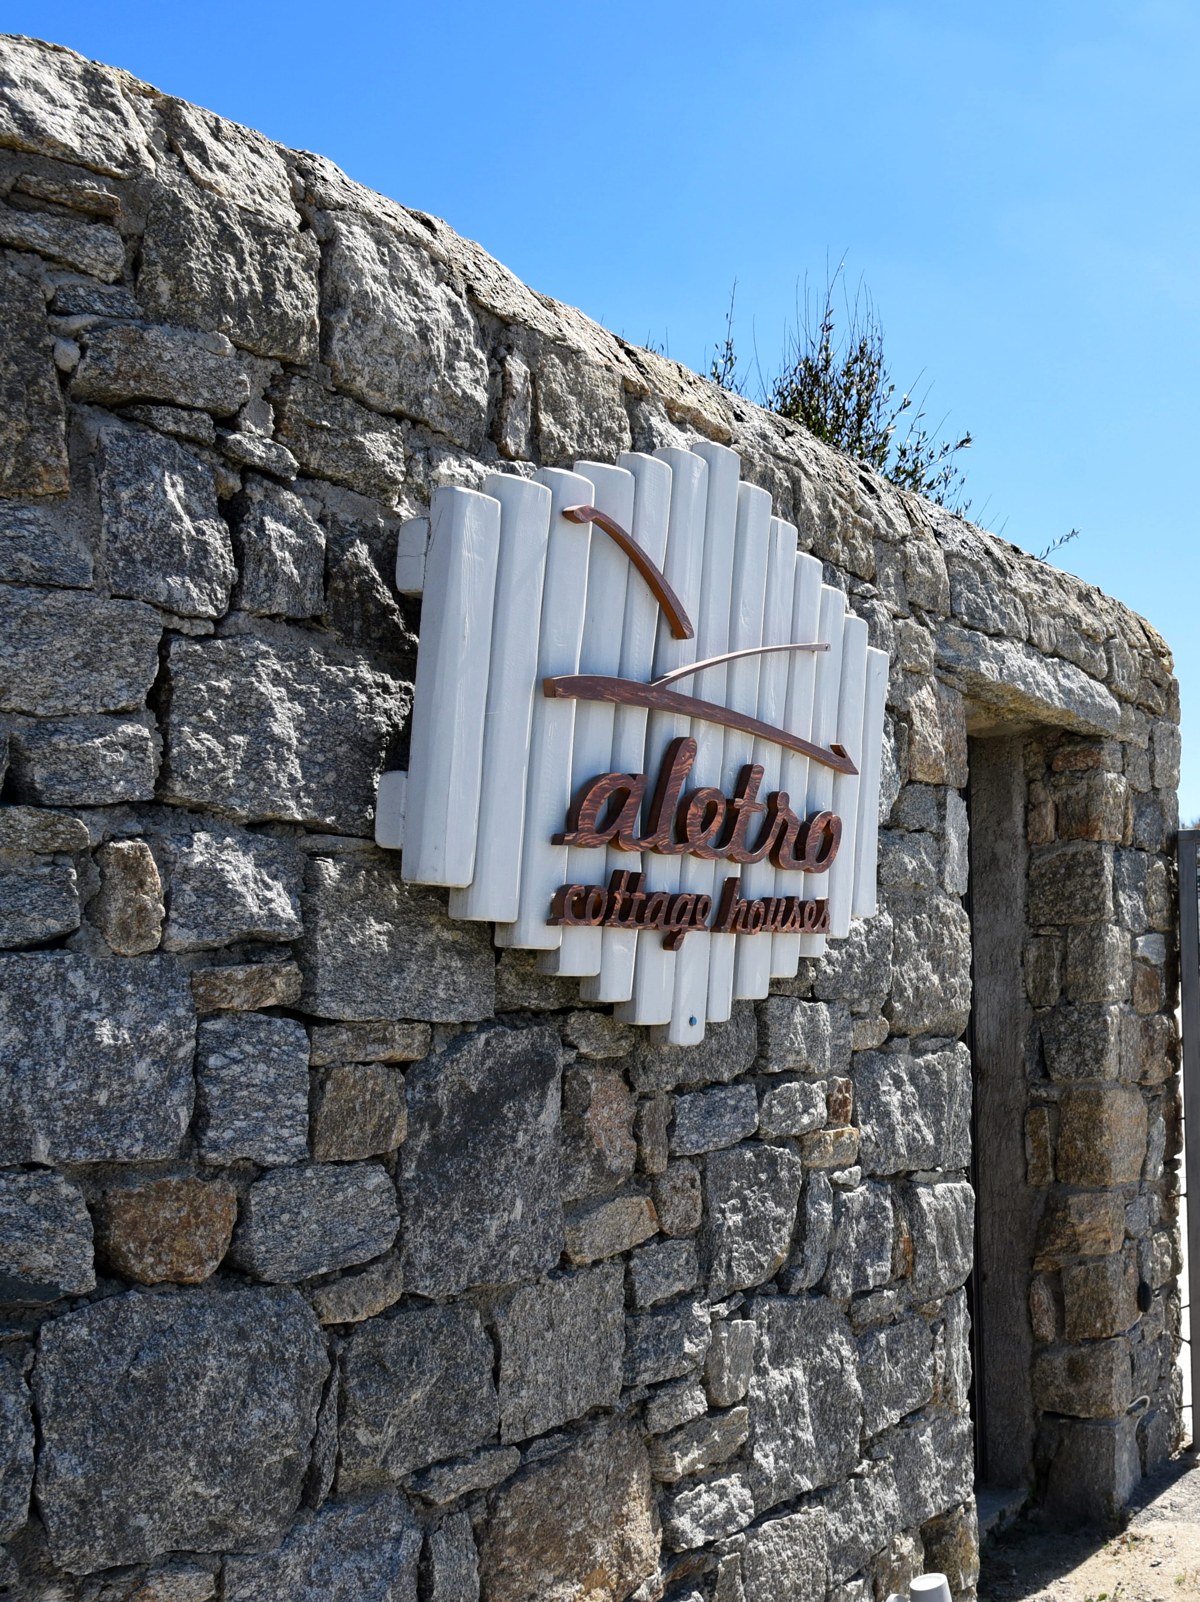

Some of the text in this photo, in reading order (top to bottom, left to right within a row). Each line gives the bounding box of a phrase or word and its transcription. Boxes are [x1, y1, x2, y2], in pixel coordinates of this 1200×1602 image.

[551, 736, 843, 873] aletro
[546, 869, 831, 951] cottage houses
